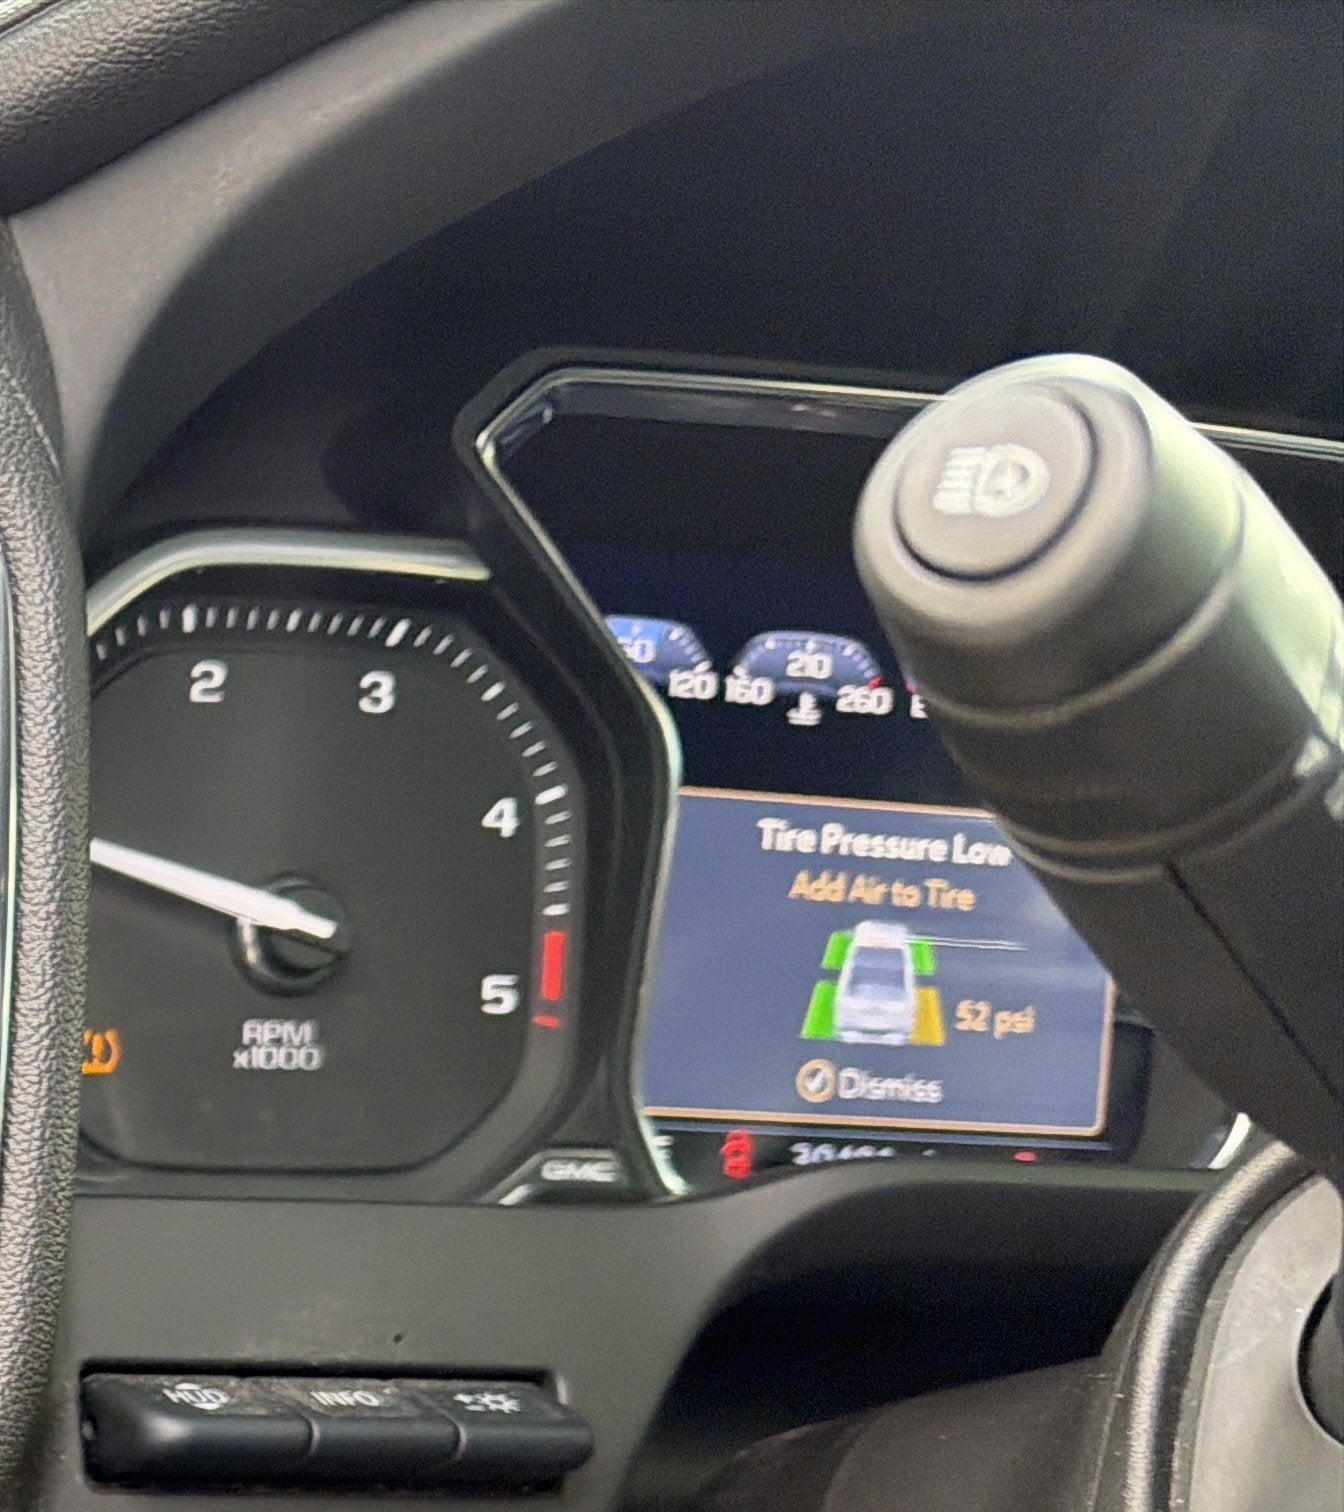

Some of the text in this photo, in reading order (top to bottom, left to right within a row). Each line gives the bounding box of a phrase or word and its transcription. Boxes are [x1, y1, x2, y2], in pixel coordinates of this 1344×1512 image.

[189, 661, 228, 703] 2
[359, 670, 395, 713] 3
[668, 669, 719, 700] 120
[724, 674, 774, 705] 160
[836, 685, 894, 715] 260
[481, 797, 519, 838] 4
[756, 817, 1011, 866] Tire Pressure Low
[788, 870, 976, 911] Add Air to Tire
[481, 974, 519, 1015] 5
[242, 1019, 316, 1046] RPM
[955, 999, 1037, 1039] 52 psi
[233, 1046, 325, 1070] x1000
[838, 1067, 944, 1103] Dismiss
[541, 1160, 616, 1182] GMC
[162, 1388, 230, 1405] HUD
[310, 1390, 380, 1407] INFO
